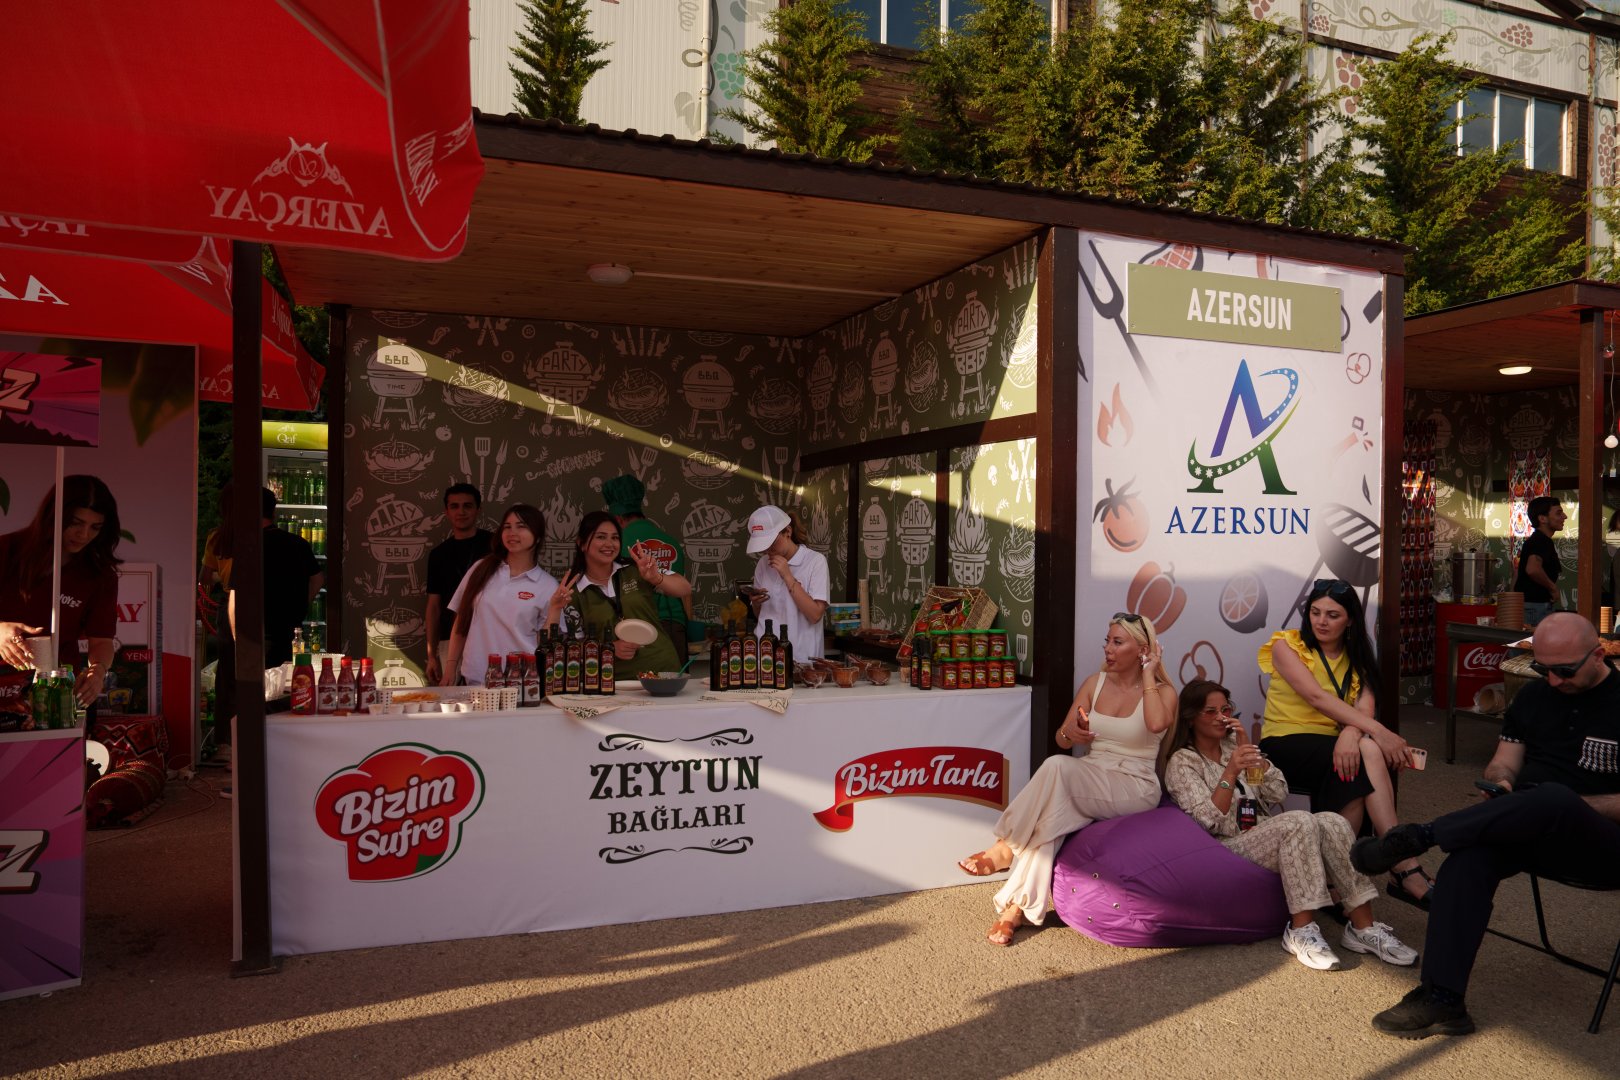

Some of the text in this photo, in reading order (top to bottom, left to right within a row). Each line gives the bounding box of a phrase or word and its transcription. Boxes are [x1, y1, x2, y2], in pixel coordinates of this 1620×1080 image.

[957, 302, 987, 334] PARTY
[1187, 287, 1292, 331] AZERSUN
[385, 355, 410, 365] BBQ
[543, 351, 587, 371] PARTY
[698, 370, 719, 380] BBQ
[276, 433, 298, 444] Qaf
[370, 500, 417, 531] PARTY
[686, 506, 726, 534] PARTY
[904, 500, 931, 525] PARTY
[1165, 505, 1311, 535] AZERSUN
[385, 547, 410, 557] BBQ
[698, 548, 719, 557] BBQ
[382, 676, 407, 686] BBQ
[588, 754, 764, 801] ZEYTUN
[840, 754, 999, 798] Bizim Tarla
[334, 774, 456, 835] Bizim
[1241, 807, 1255, 816] BBQ
[607, 803, 746, 835] BAĞLARI
[357, 816, 446, 863] Sufre
